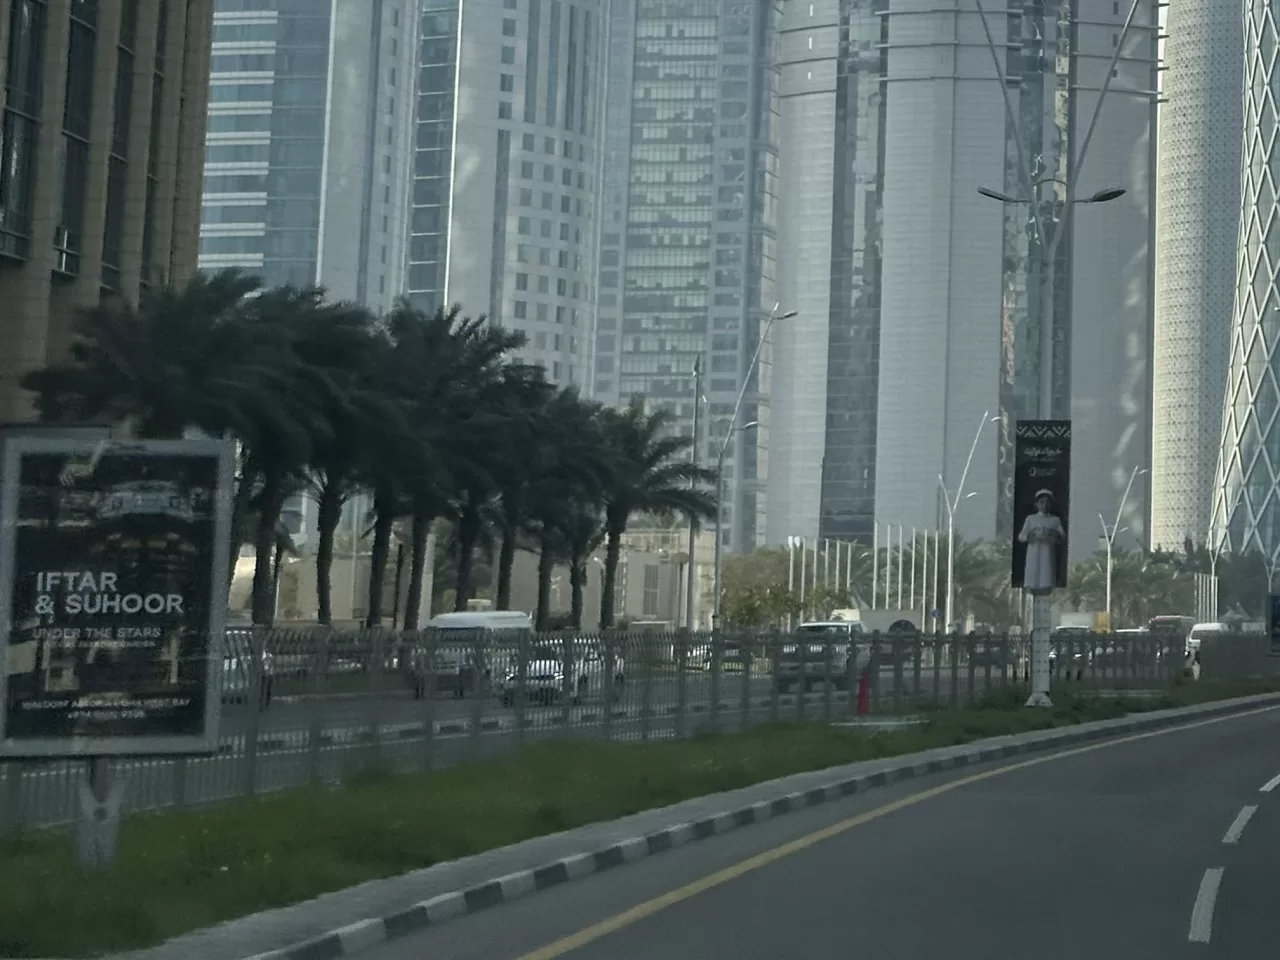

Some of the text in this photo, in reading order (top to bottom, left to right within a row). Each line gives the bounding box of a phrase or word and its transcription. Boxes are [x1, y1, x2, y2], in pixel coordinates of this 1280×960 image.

[36, 571, 118, 591] IFTAR
[35, 593, 184, 614] & SUHOOR
[32, 628, 161, 639] UNDER THE STARS
